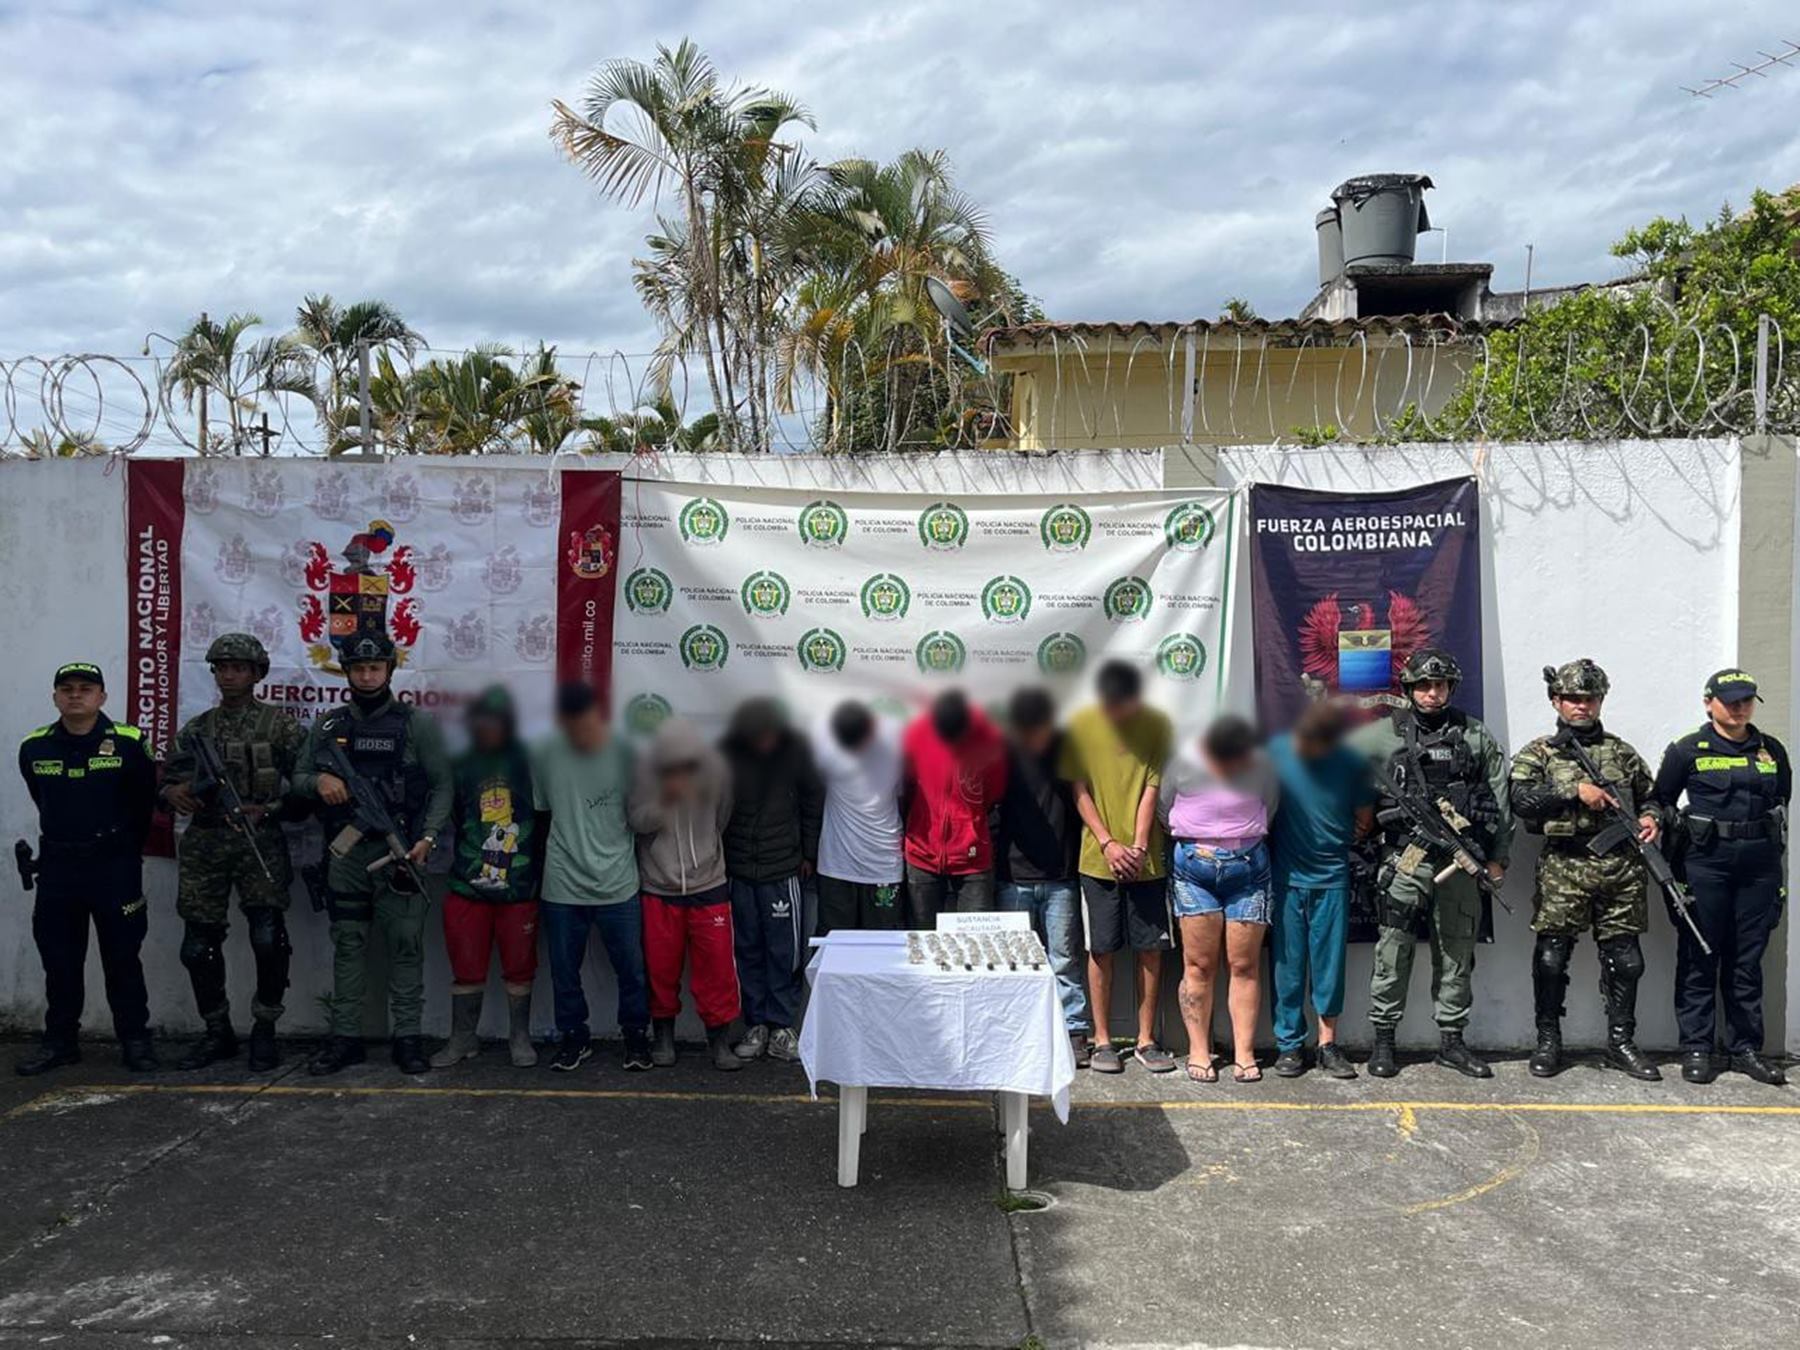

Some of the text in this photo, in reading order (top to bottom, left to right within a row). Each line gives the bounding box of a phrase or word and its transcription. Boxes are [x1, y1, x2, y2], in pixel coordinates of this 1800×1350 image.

[1257, 512, 1466, 534] FUERZA AEROESPACIAL
[1293, 530, 1433, 552] COLOMBIANA
[137, 525, 155, 649] NACIONAL
[155, 539, 170, 761] PATRIA HONOR Y LIBERTAD
[256, 684, 352, 703] JERCITO
[358, 739, 392, 750] GOES
